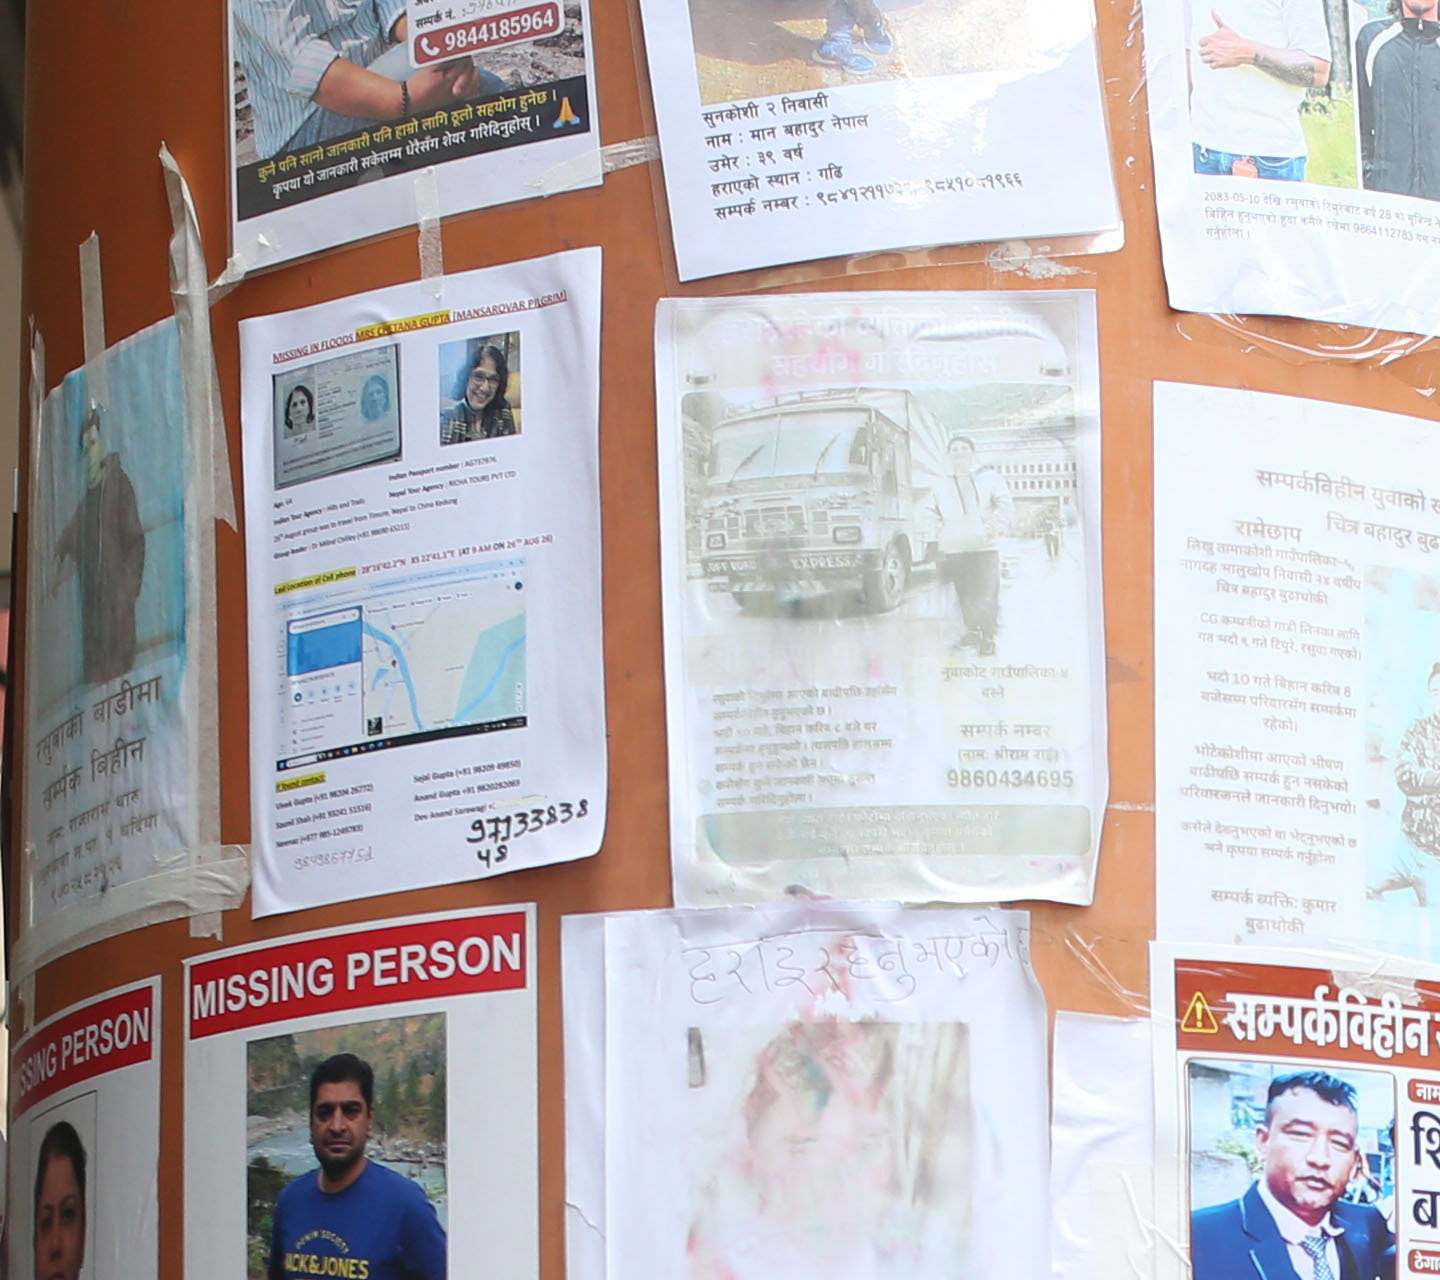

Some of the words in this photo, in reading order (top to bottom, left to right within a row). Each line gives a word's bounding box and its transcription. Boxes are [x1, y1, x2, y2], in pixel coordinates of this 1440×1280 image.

[445, 13, 554, 51] 9844185964
[702, 103, 759, 129] सुनकोशी
[767, 101, 776, 116] २
[782, 92, 829, 114] निवासी
[258, 159, 277, 183] कुनै
[278, 152, 297, 173] पनि
[299, 144, 324, 169] सानो
[327, 131, 370, 164] जानकारी
[373, 124, 393, 143] पनि
[395, 116, 419, 140] हाम्रो
[421, 109, 449, 131] लागि
[451, 103, 473, 128] ठूलो
[476, 95, 516, 118] सहयोग
[519, 90, 548, 114] हुनेछ
[705, 133, 732, 149] नाम
[750, 126, 776, 143] मान
[784, 120, 824, 139] बहादुर
[831, 112, 869, 130] नेपाल
[272, 174, 300, 199] कृपया
[303, 165, 315, 184] यो
[316, 155, 359, 182] जानकारी
[361, 146, 402, 170] सकेसम्म
[405, 133, 439, 159] धेरैसँग
[442, 126, 466, 149] शेयर
[470, 115, 532, 143] गरिदिनुहोस्
[708, 154, 739, 173] उमेर
[757, 150, 776, 165] ३९
[782, 143, 804, 160] वर्ष
[711, 174, 760, 198] हराएको
[766, 171, 800, 188] स्थान
[818, 163, 843, 180] गढि
[715, 198, 756, 221] सम्पर्क
[762, 195, 799, 212] नम्बर
[1379, 209, 1392, 220] 28
[1256, 468, 1365, 502] सम्पर्कविहीन
[1372, 487, 1426, 515] युवाको
[1236, 519, 1302, 542] रामेछाप
[1364, 520, 1412, 547] बहादुर
[947, 769, 1074, 788] 9860434695
[193, 958, 334, 1021] MISSING
[347, 933, 521, 990] PERSON
[62, 1007, 149, 1070] PERSON
[1226, 986, 1431, 1058] सम्पर्कविहीन
